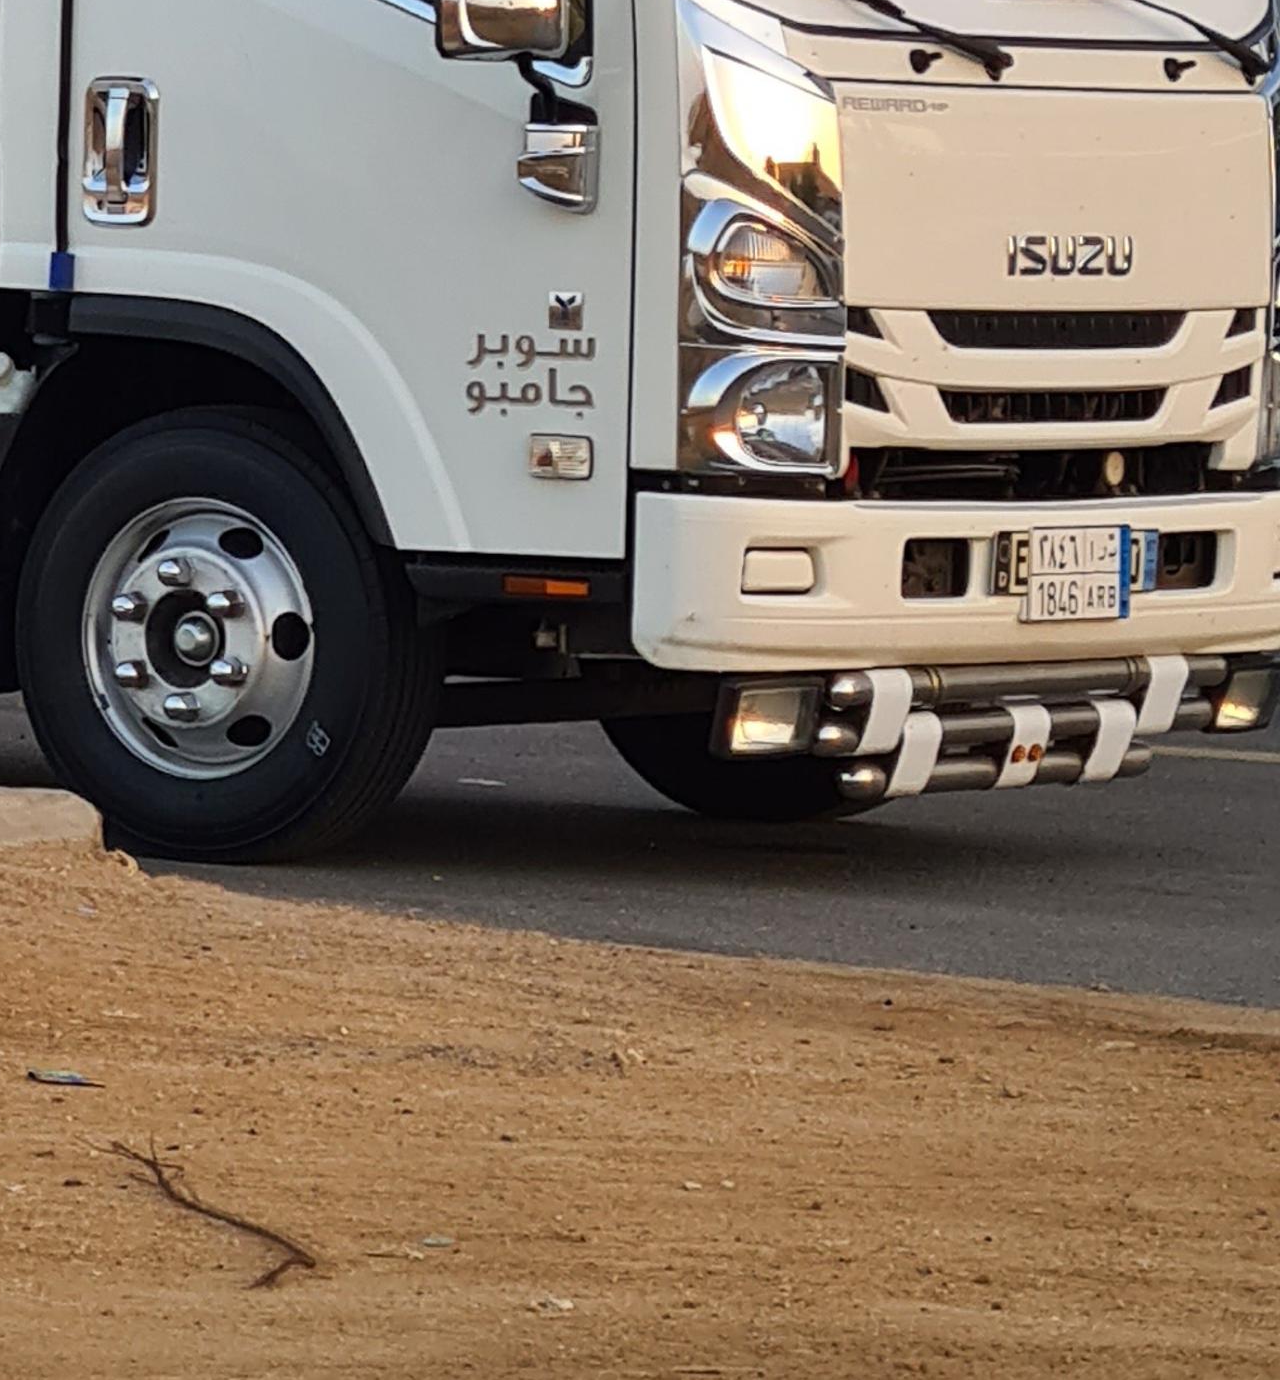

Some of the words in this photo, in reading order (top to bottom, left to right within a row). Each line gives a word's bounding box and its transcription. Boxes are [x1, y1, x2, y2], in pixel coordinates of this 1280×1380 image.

[1007, 235, 1134, 277] ISUZU
[465, 333, 597, 370] سوبر
[465, 368, 595, 419] جامبو
[1038, 580, 1080, 616] 1846
[1086, 585, 1117, 609] ARB
